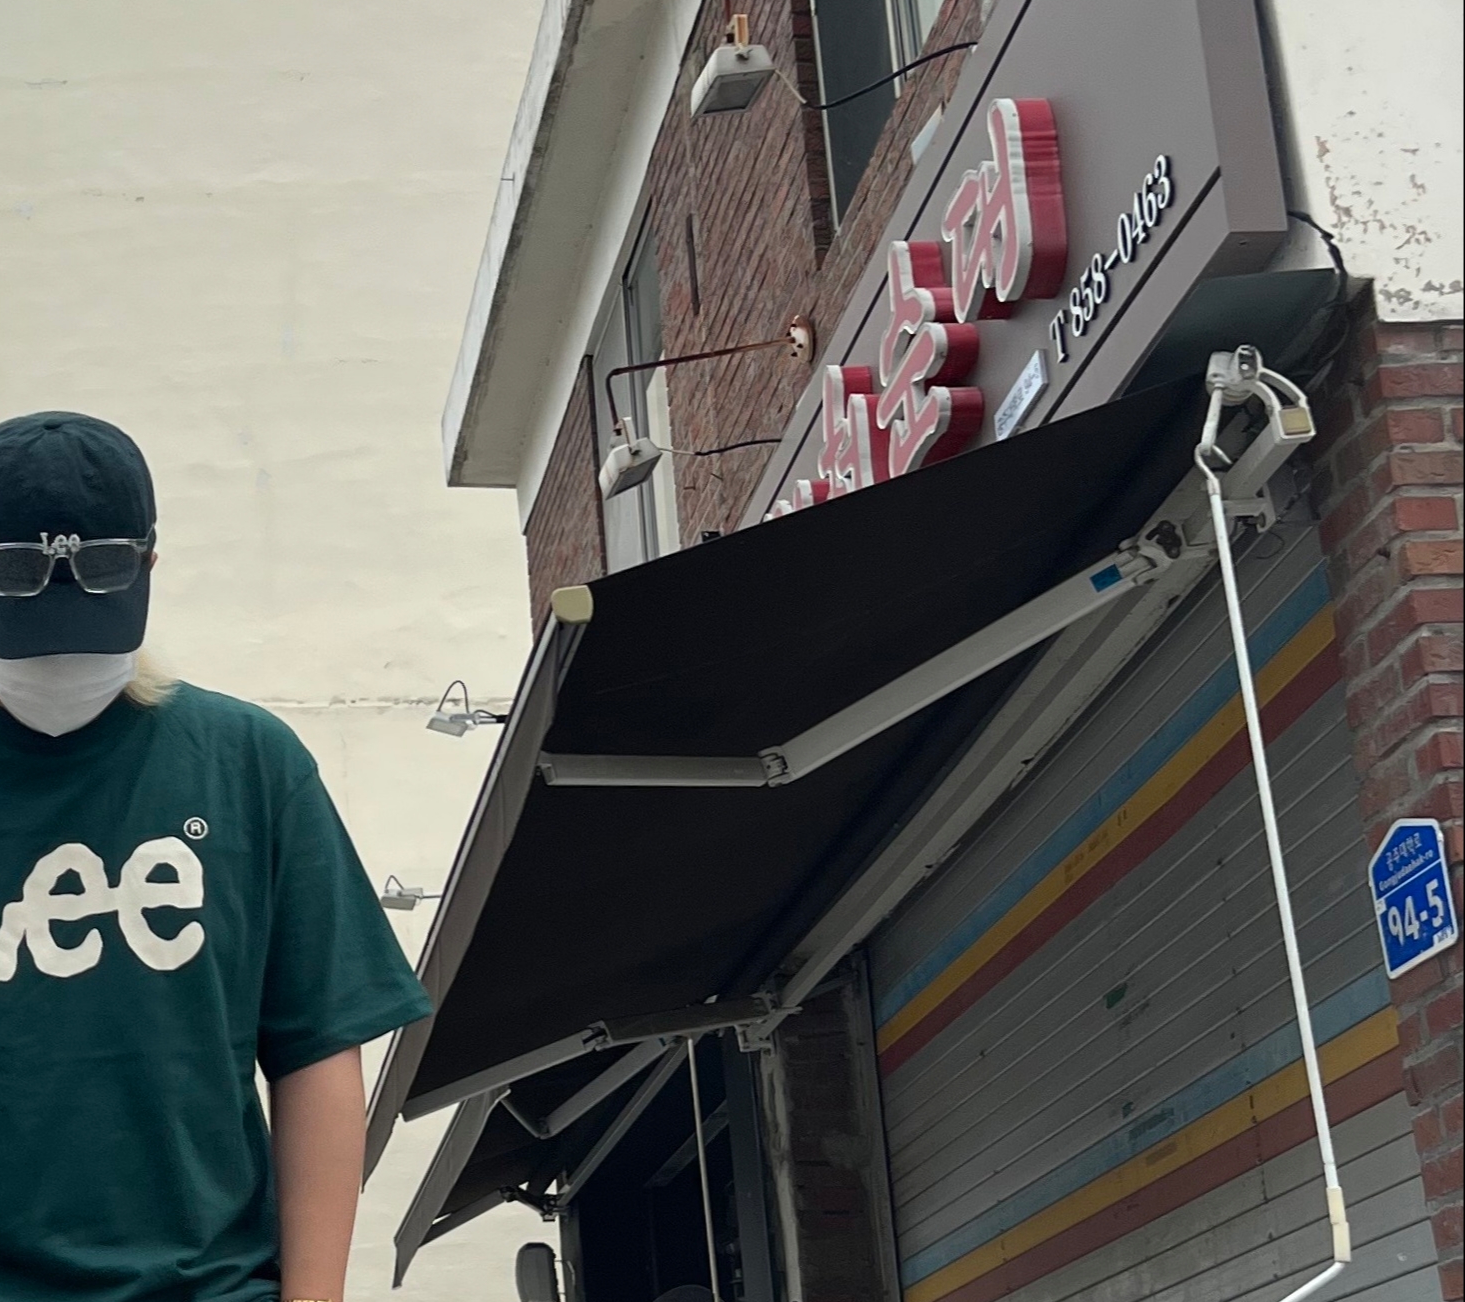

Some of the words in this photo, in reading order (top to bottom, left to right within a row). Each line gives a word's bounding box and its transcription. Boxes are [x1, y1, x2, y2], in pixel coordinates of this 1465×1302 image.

[764, 97, 1067, 519] 순대
[1049, 308, 1071, 364] T
[1068, 153, 1173, 339] 858-0463
[39, 531, 81, 556] Lee
[1387, 878, 1445, 947] 94-5
